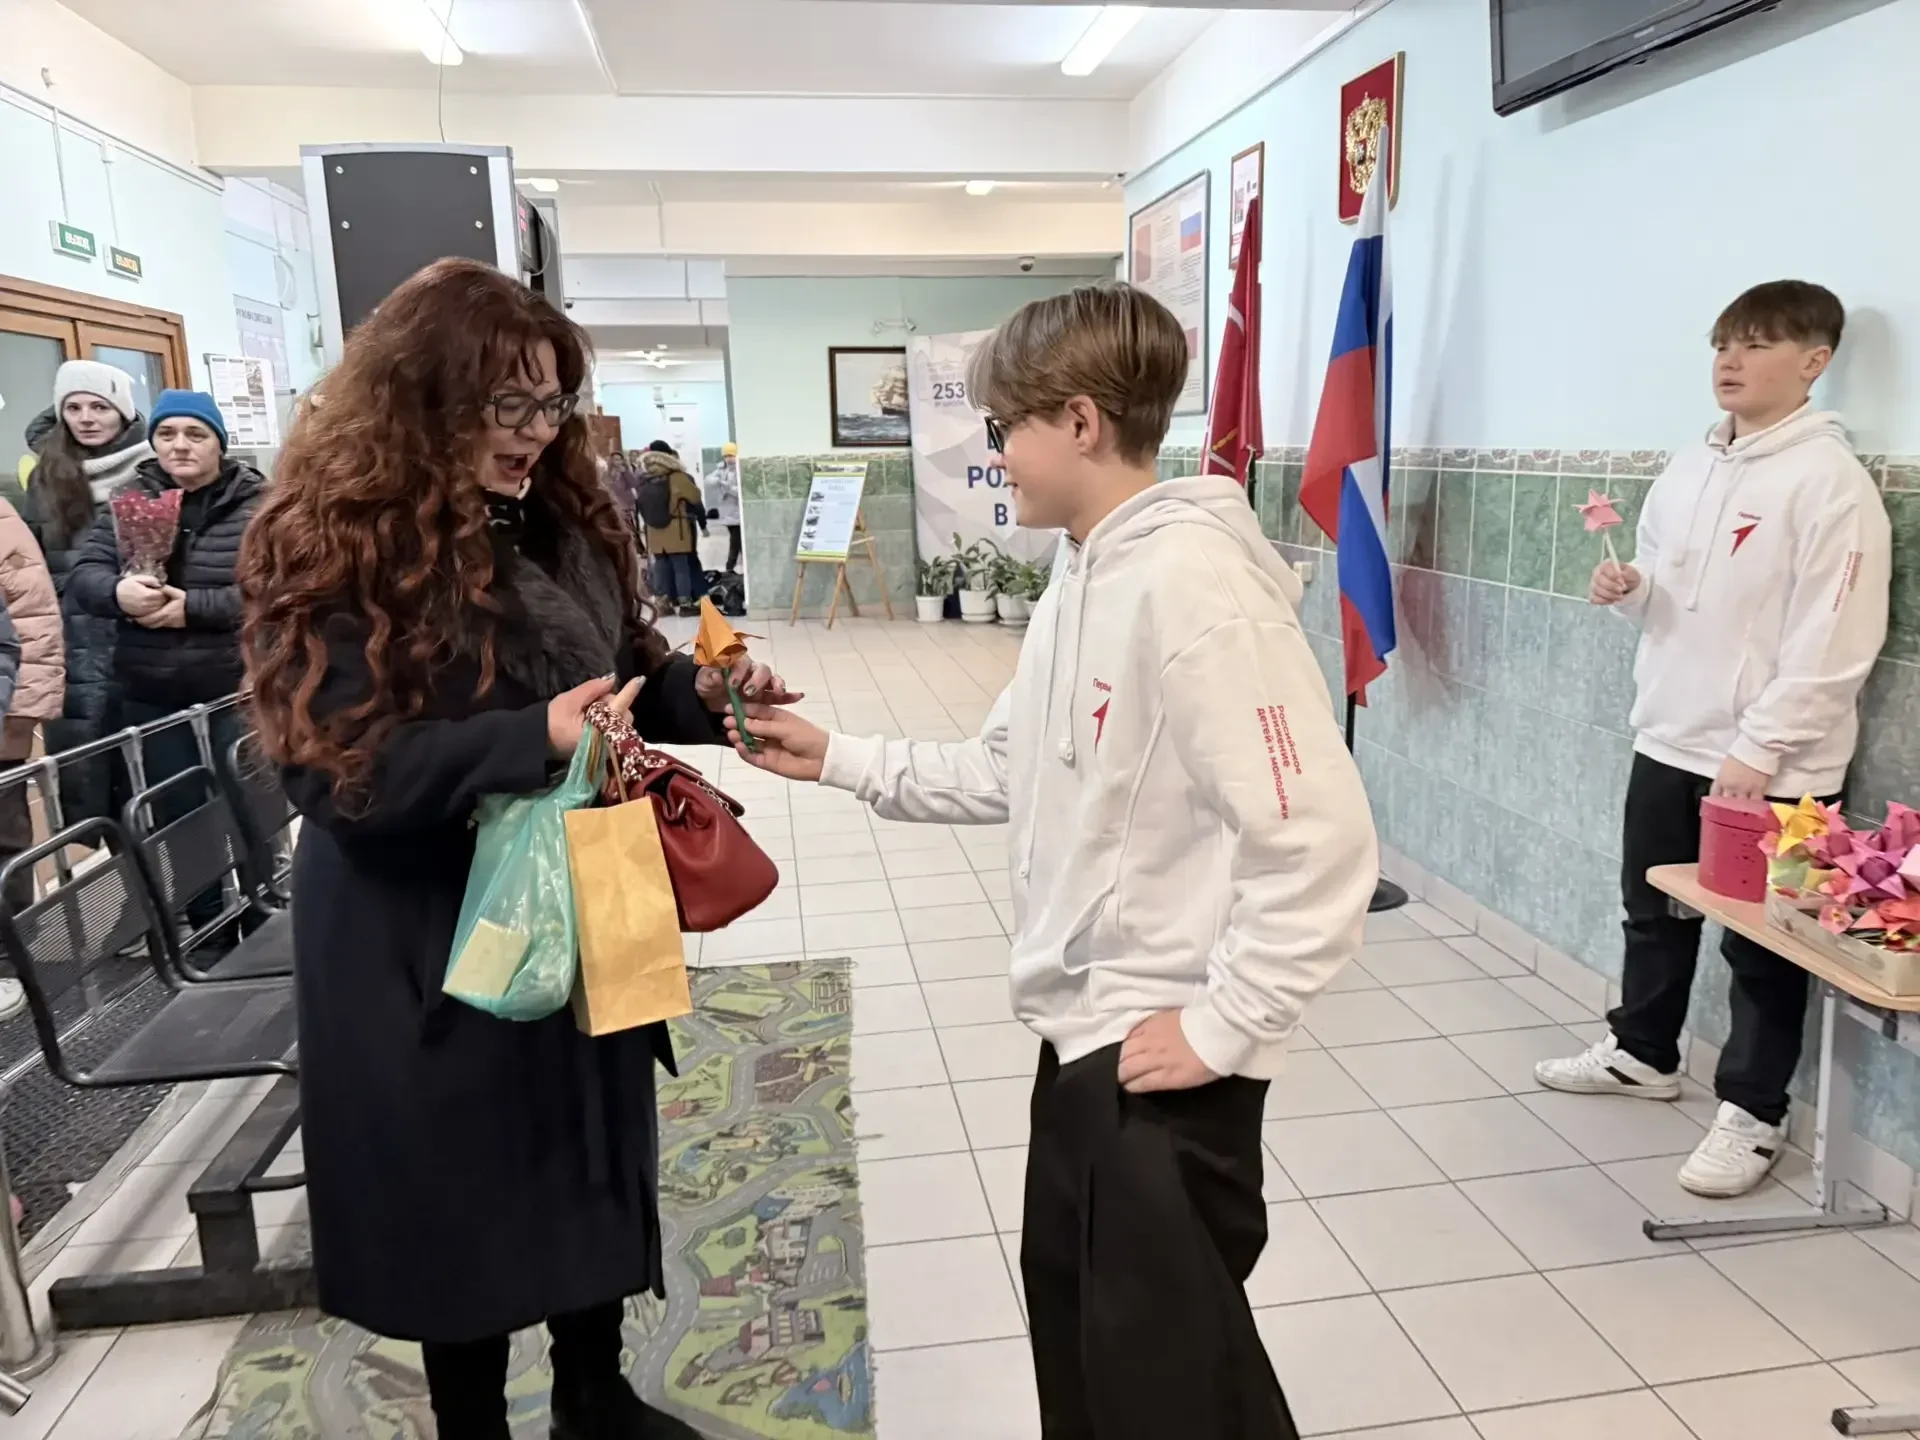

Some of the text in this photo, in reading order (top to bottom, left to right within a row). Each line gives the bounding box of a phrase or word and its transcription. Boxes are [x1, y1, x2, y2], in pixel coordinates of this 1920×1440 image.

[932, 381, 965, 400] 253
[967, 465, 1008, 488] РО
[1256, 707, 1274, 744] детей
[1270, 756, 1288, 820] молодёжи
[1267, 705, 1290, 768] движение
[1276, 705, 1302, 775] Российское
